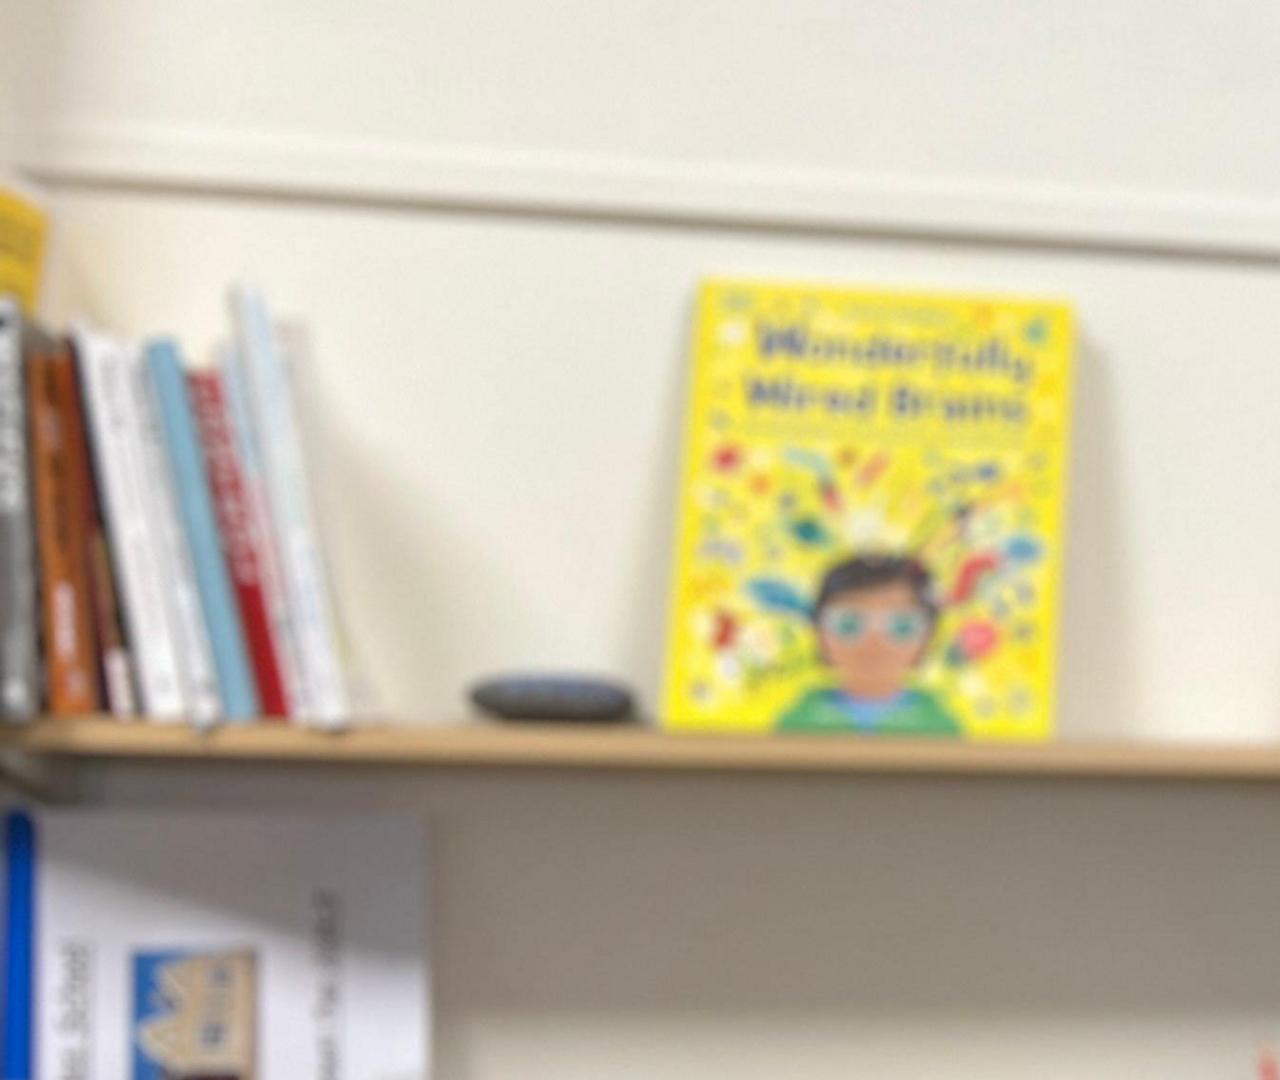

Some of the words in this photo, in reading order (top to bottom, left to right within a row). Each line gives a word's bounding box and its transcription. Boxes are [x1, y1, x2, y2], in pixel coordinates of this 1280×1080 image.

[754, 323, 1034, 384] Wonderfully
[747, 378, 876, 416] Wired
[893, 384, 1027, 420] Brains
